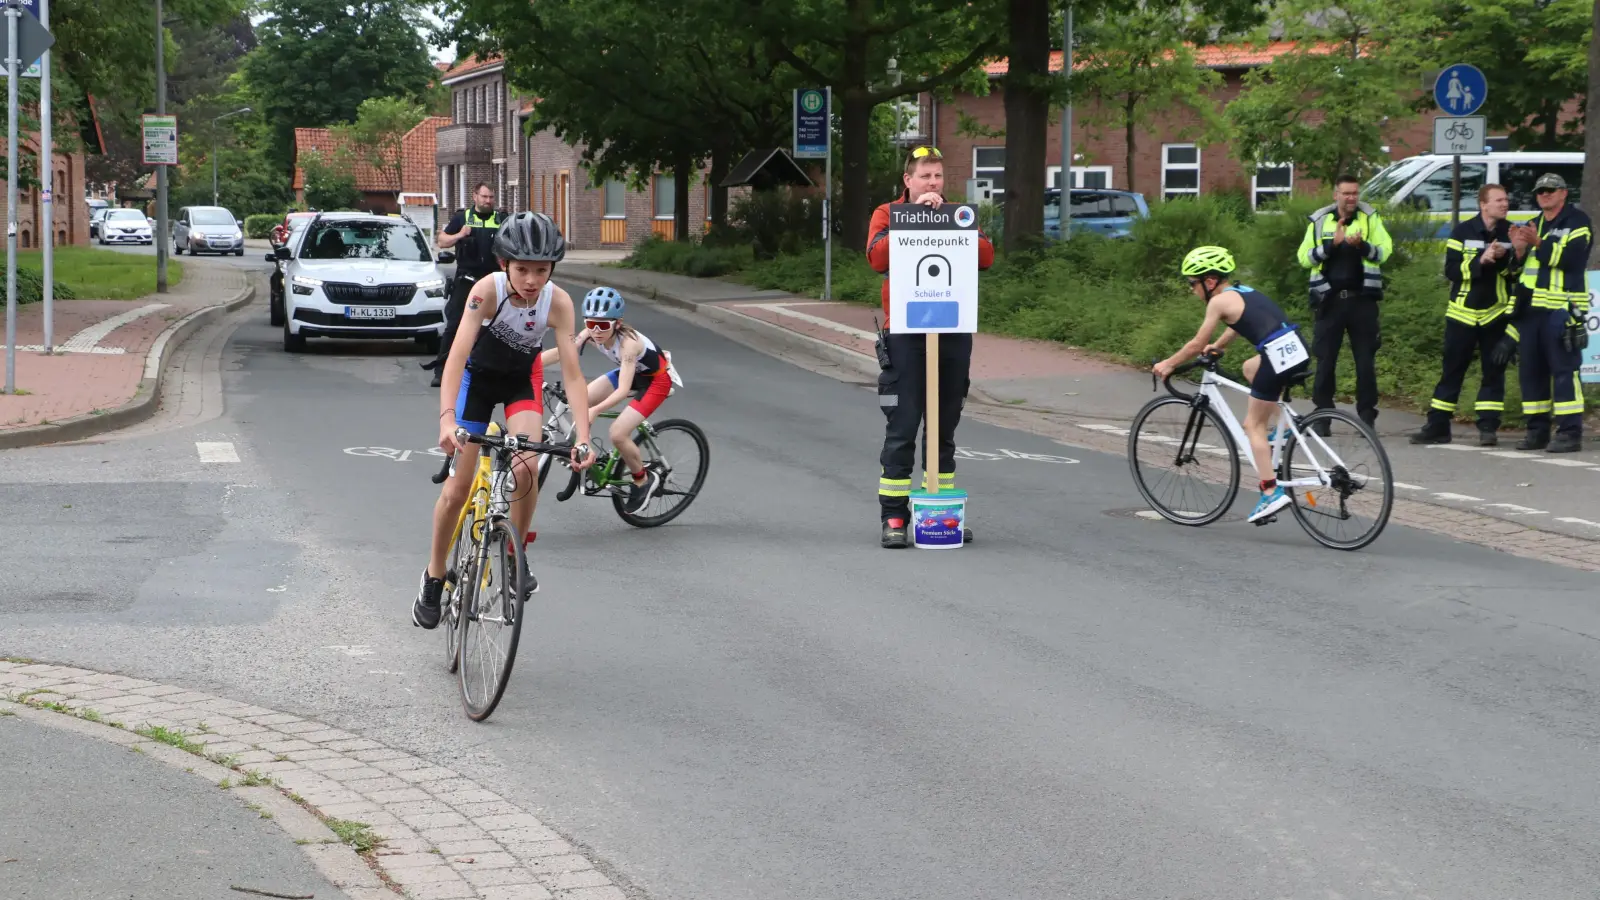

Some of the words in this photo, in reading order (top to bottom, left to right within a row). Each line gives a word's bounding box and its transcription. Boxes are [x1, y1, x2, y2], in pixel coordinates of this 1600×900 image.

[1451, 142, 1468, 150] frei
[893, 211, 949, 223] Triathlon
[898, 236, 970, 248] Wendepunkt
[914, 290, 943, 298] Schüler
[350, 308, 357, 316] H
[373, 308, 394, 317] 1313
[1276, 340, 1298, 358] 766
